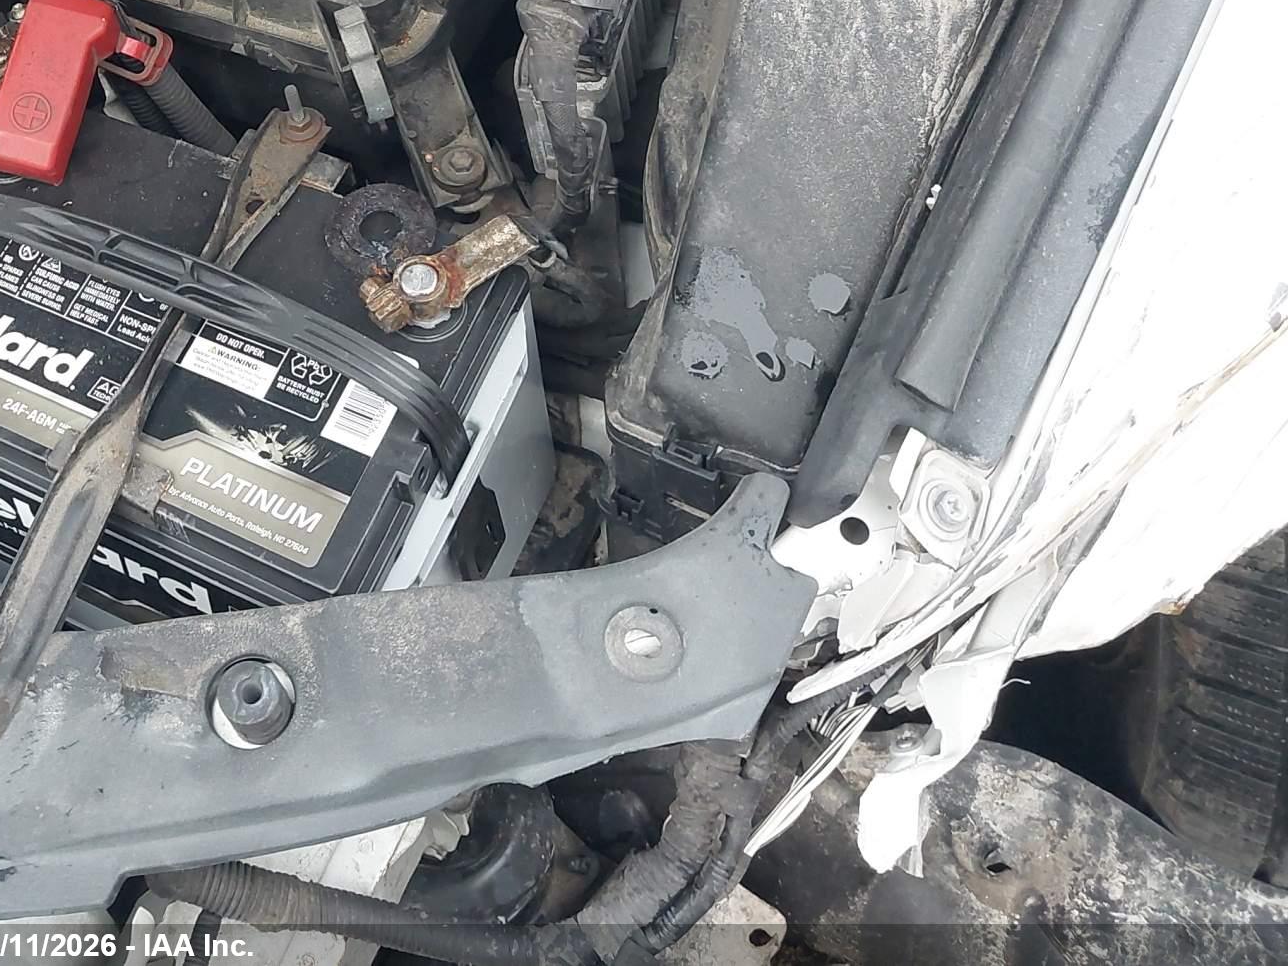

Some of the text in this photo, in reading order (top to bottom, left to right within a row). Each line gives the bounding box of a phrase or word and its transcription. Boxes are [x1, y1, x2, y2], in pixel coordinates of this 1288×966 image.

[117, 324, 136, 338] Lead
[215, 332, 227, 342] DO
[226, 336, 244, 350] NOT
[307, 359, 321, 371] Pb
[275, 381, 321, 405] BE RECYCLED
[277, 375, 326, 398] BATTERY MUST
[2, 397, 58, 431] 24F-AGM
[179, 456, 325, 534] PLATINUM
[179, 491, 209, 510] Advance
[207, 504, 226, 518] Auto
[225, 511, 245, 529] Parts,
[245, 521, 273, 539] Raleigh,
[273, 533, 286, 544] NC
[284, 538, 310, 555] 27604
